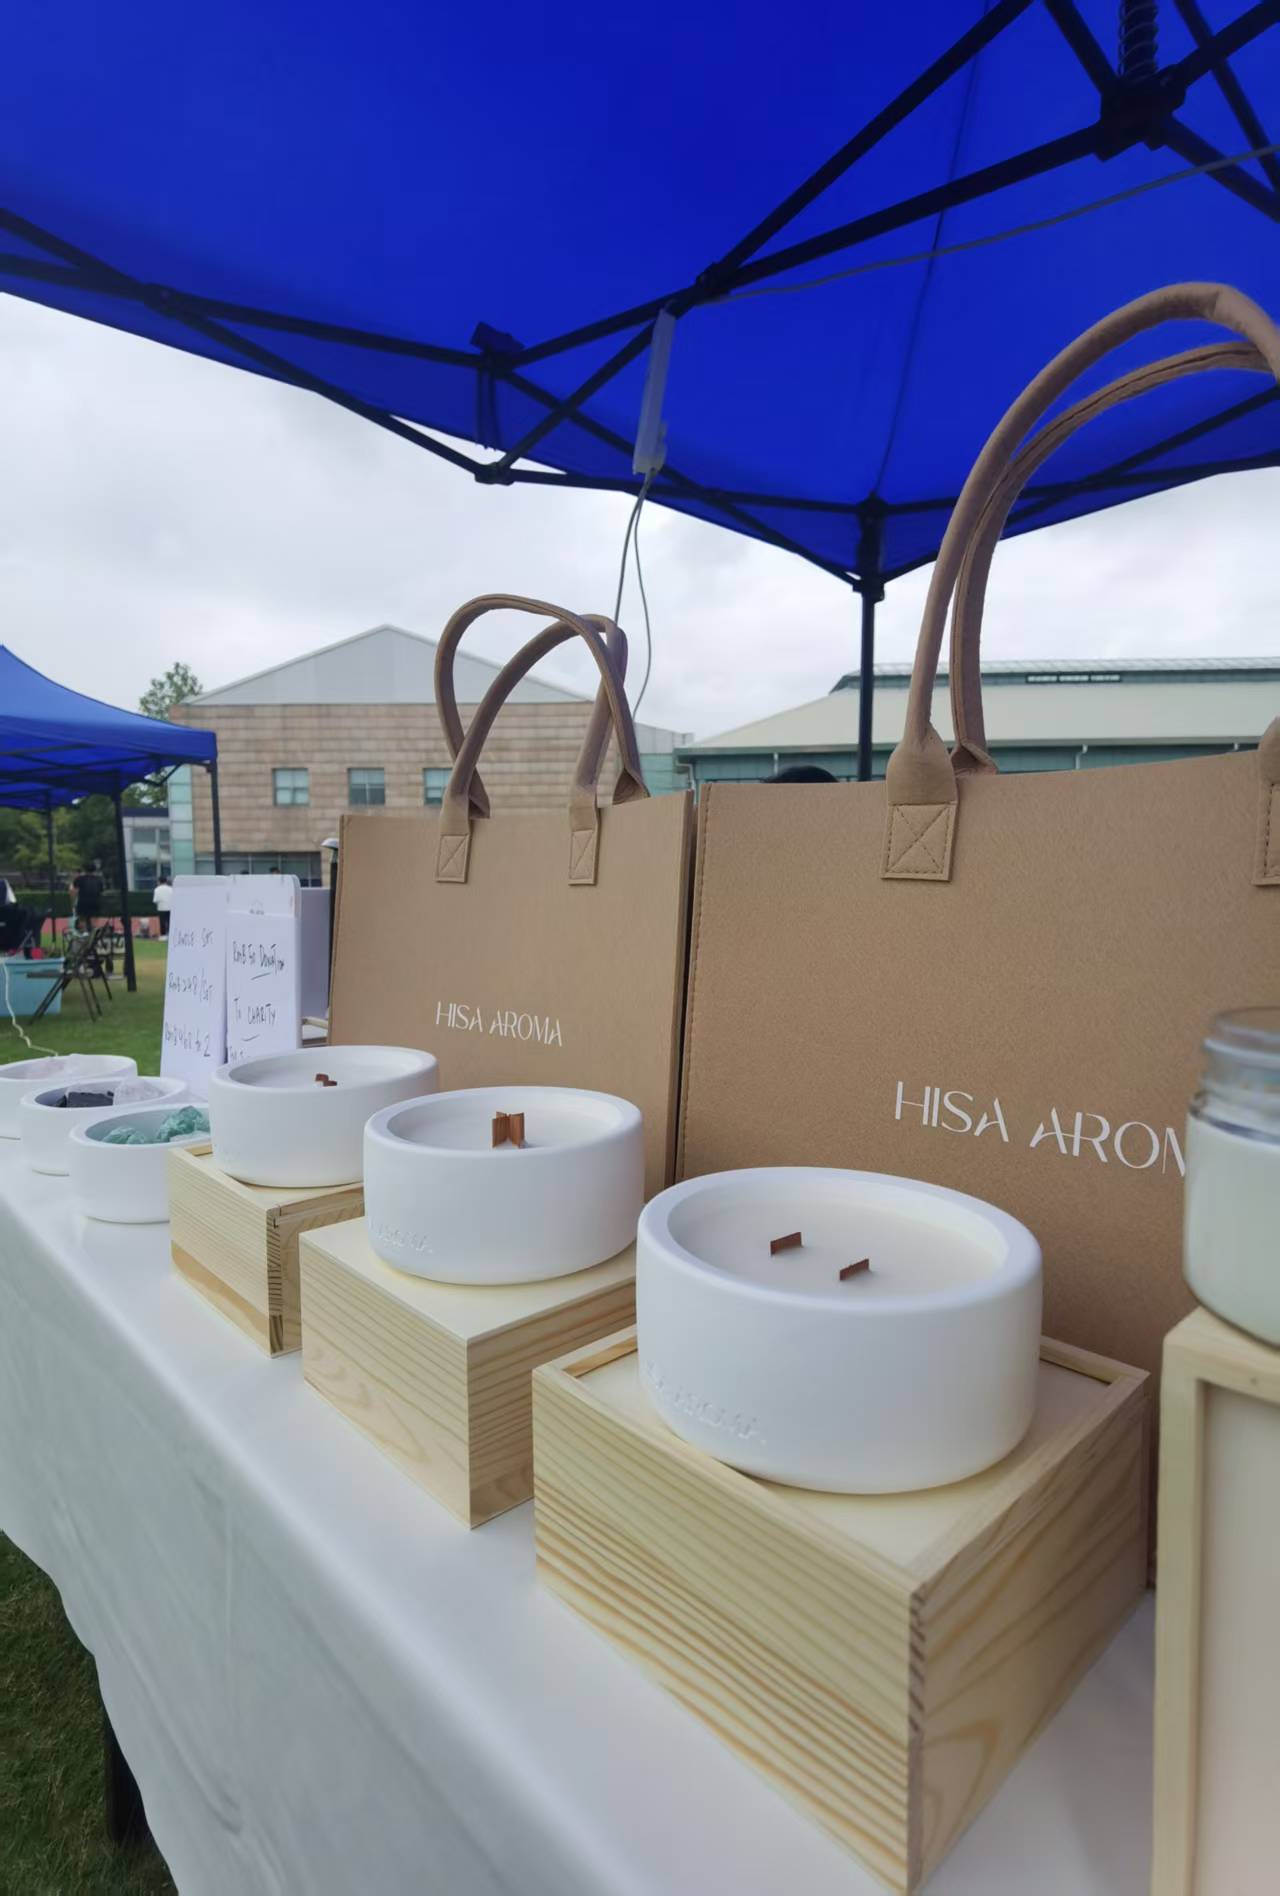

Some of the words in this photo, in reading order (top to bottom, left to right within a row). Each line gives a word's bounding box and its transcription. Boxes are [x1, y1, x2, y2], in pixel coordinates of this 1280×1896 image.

[247, 1003, 276, 1027] CHARITY
[435, 1000, 483, 1033] HISA
[489, 1008, 562, 1047] AROMA
[895, 1081, 1009, 1142] HISA
